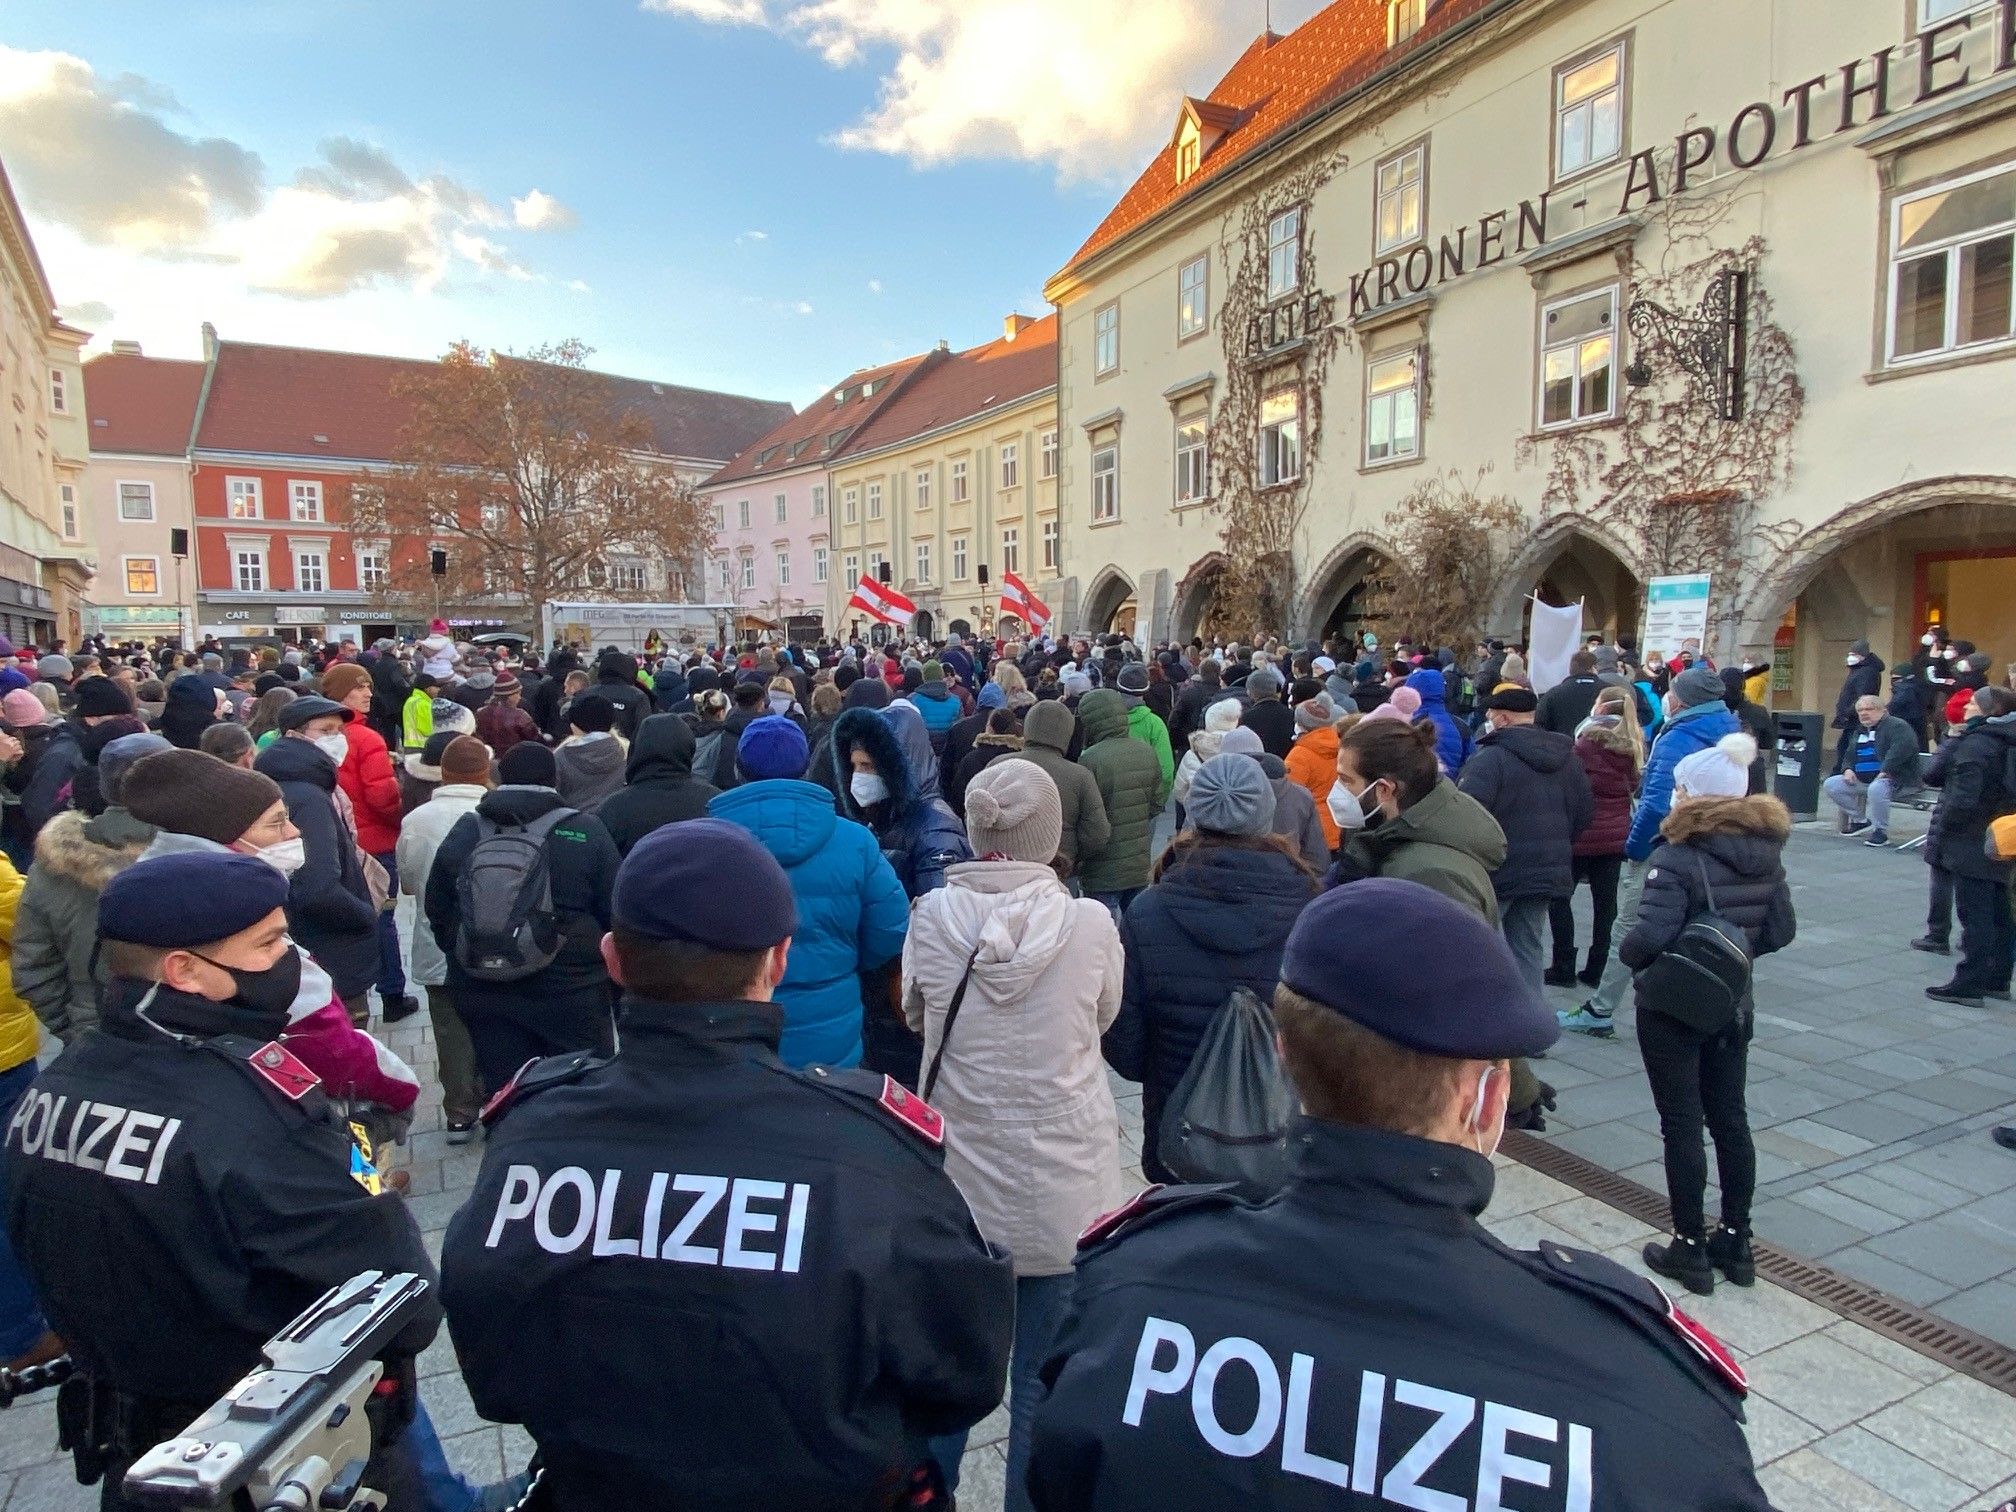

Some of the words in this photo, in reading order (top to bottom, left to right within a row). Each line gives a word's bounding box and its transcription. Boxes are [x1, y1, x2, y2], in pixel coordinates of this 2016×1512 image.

[1347, 192, 1552, 322] KRONEN
[225, 611, 250, 620] CAFE
[340, 611, 392, 620] KONDITOREI
[5, 1088, 181, 1184] POLIZEI
[485, 1165, 811, 1273] POLIZEI
[1122, 1316, 1593, 1512] POLIZEI
